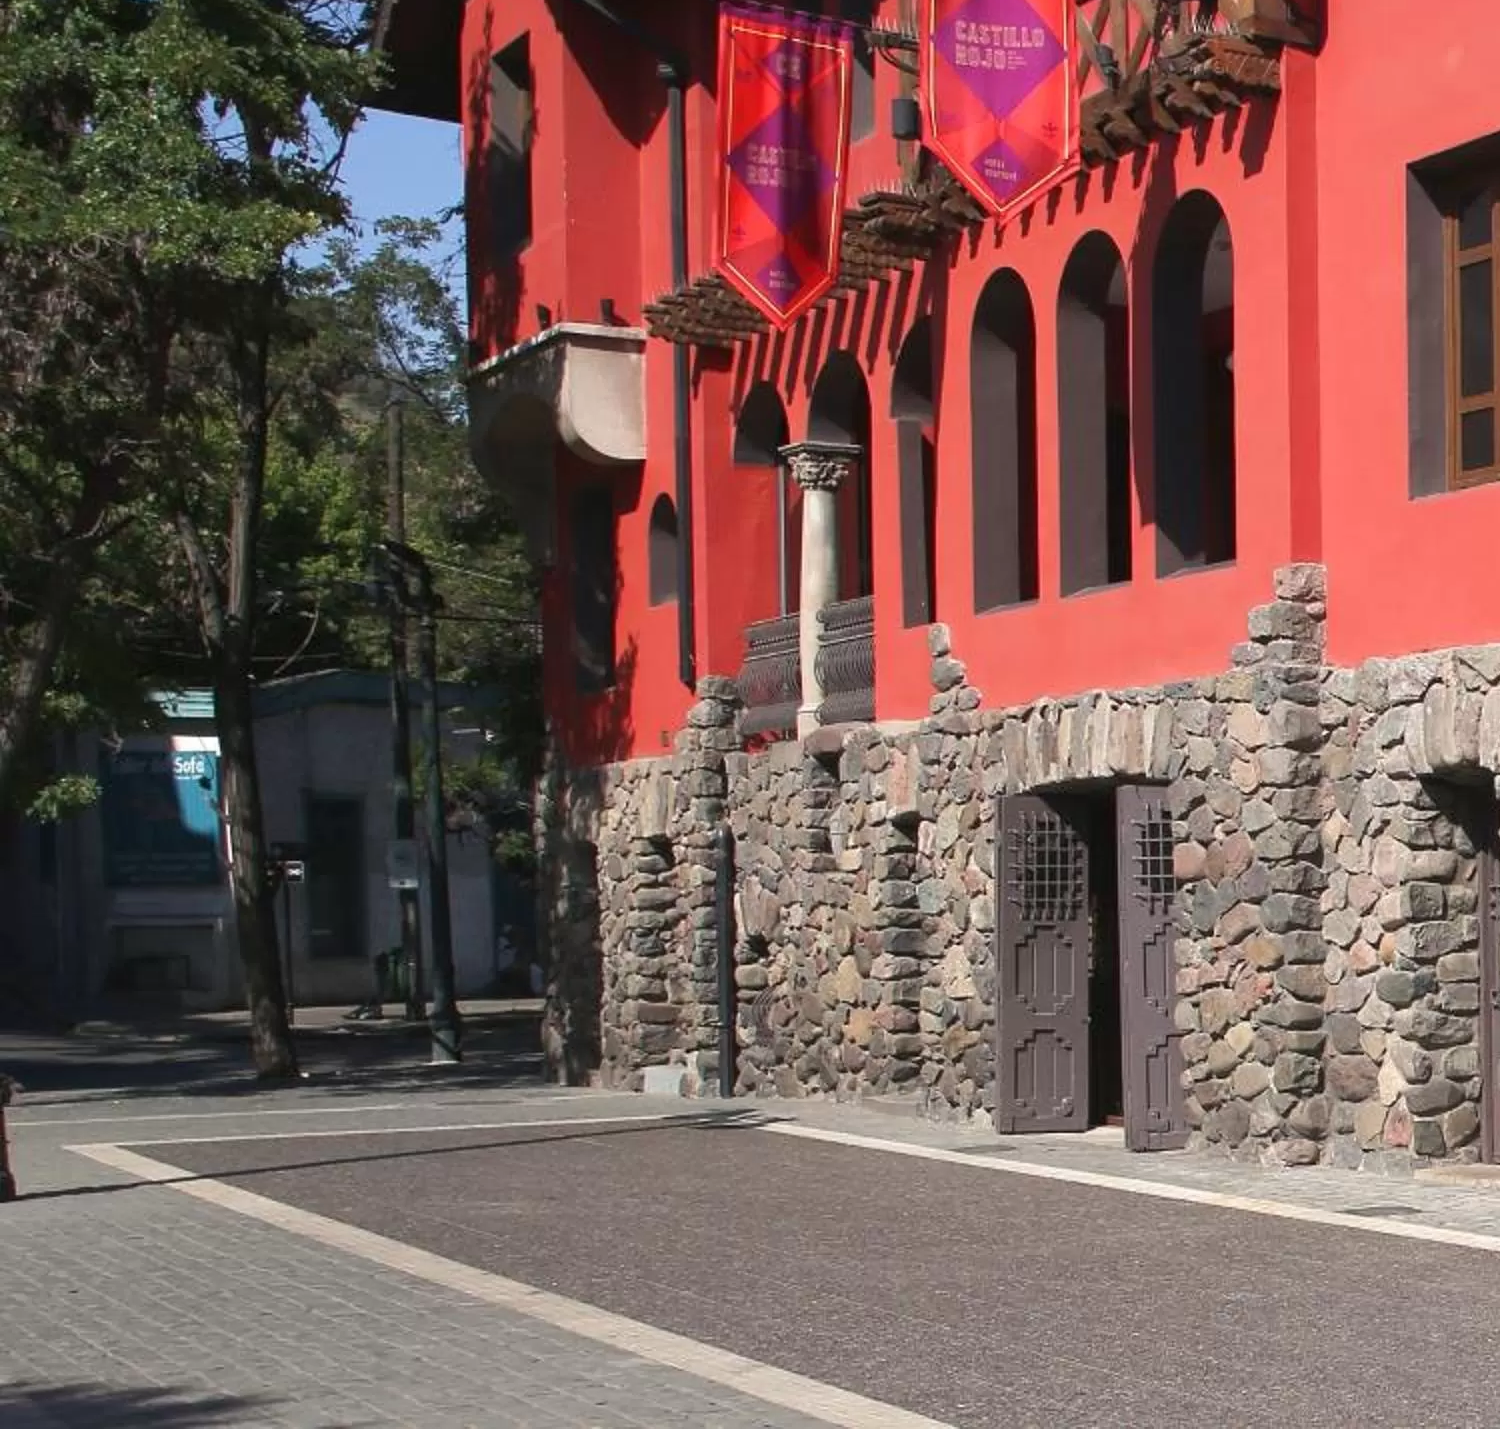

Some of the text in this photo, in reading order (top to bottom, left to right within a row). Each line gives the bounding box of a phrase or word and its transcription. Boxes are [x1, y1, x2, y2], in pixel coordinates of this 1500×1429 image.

[955, 20, 1045, 48] CASTILLO
[955, 43, 1006, 70] ROJO
[747, 143, 817, 171] CASTO
